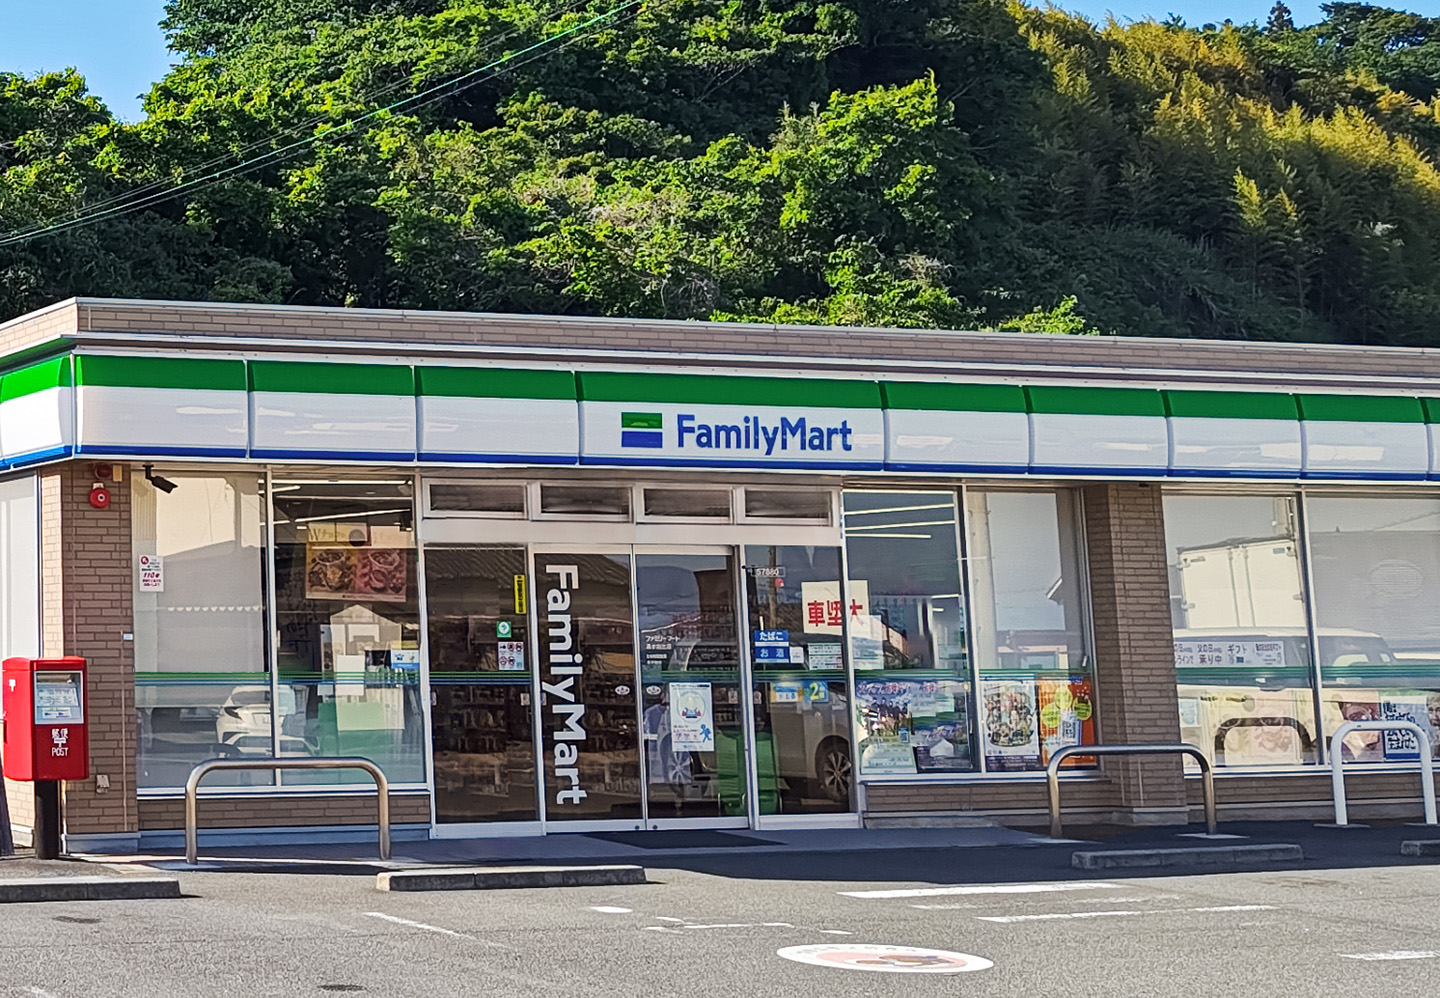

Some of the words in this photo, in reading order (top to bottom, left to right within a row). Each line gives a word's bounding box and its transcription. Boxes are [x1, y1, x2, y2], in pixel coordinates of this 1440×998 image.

[677, 414, 853, 456] FamilyMart
[759, 631, 784, 641] たばこ
[542, 564, 588, 805] FamilyMart
[51, 747, 69, 757] POST
